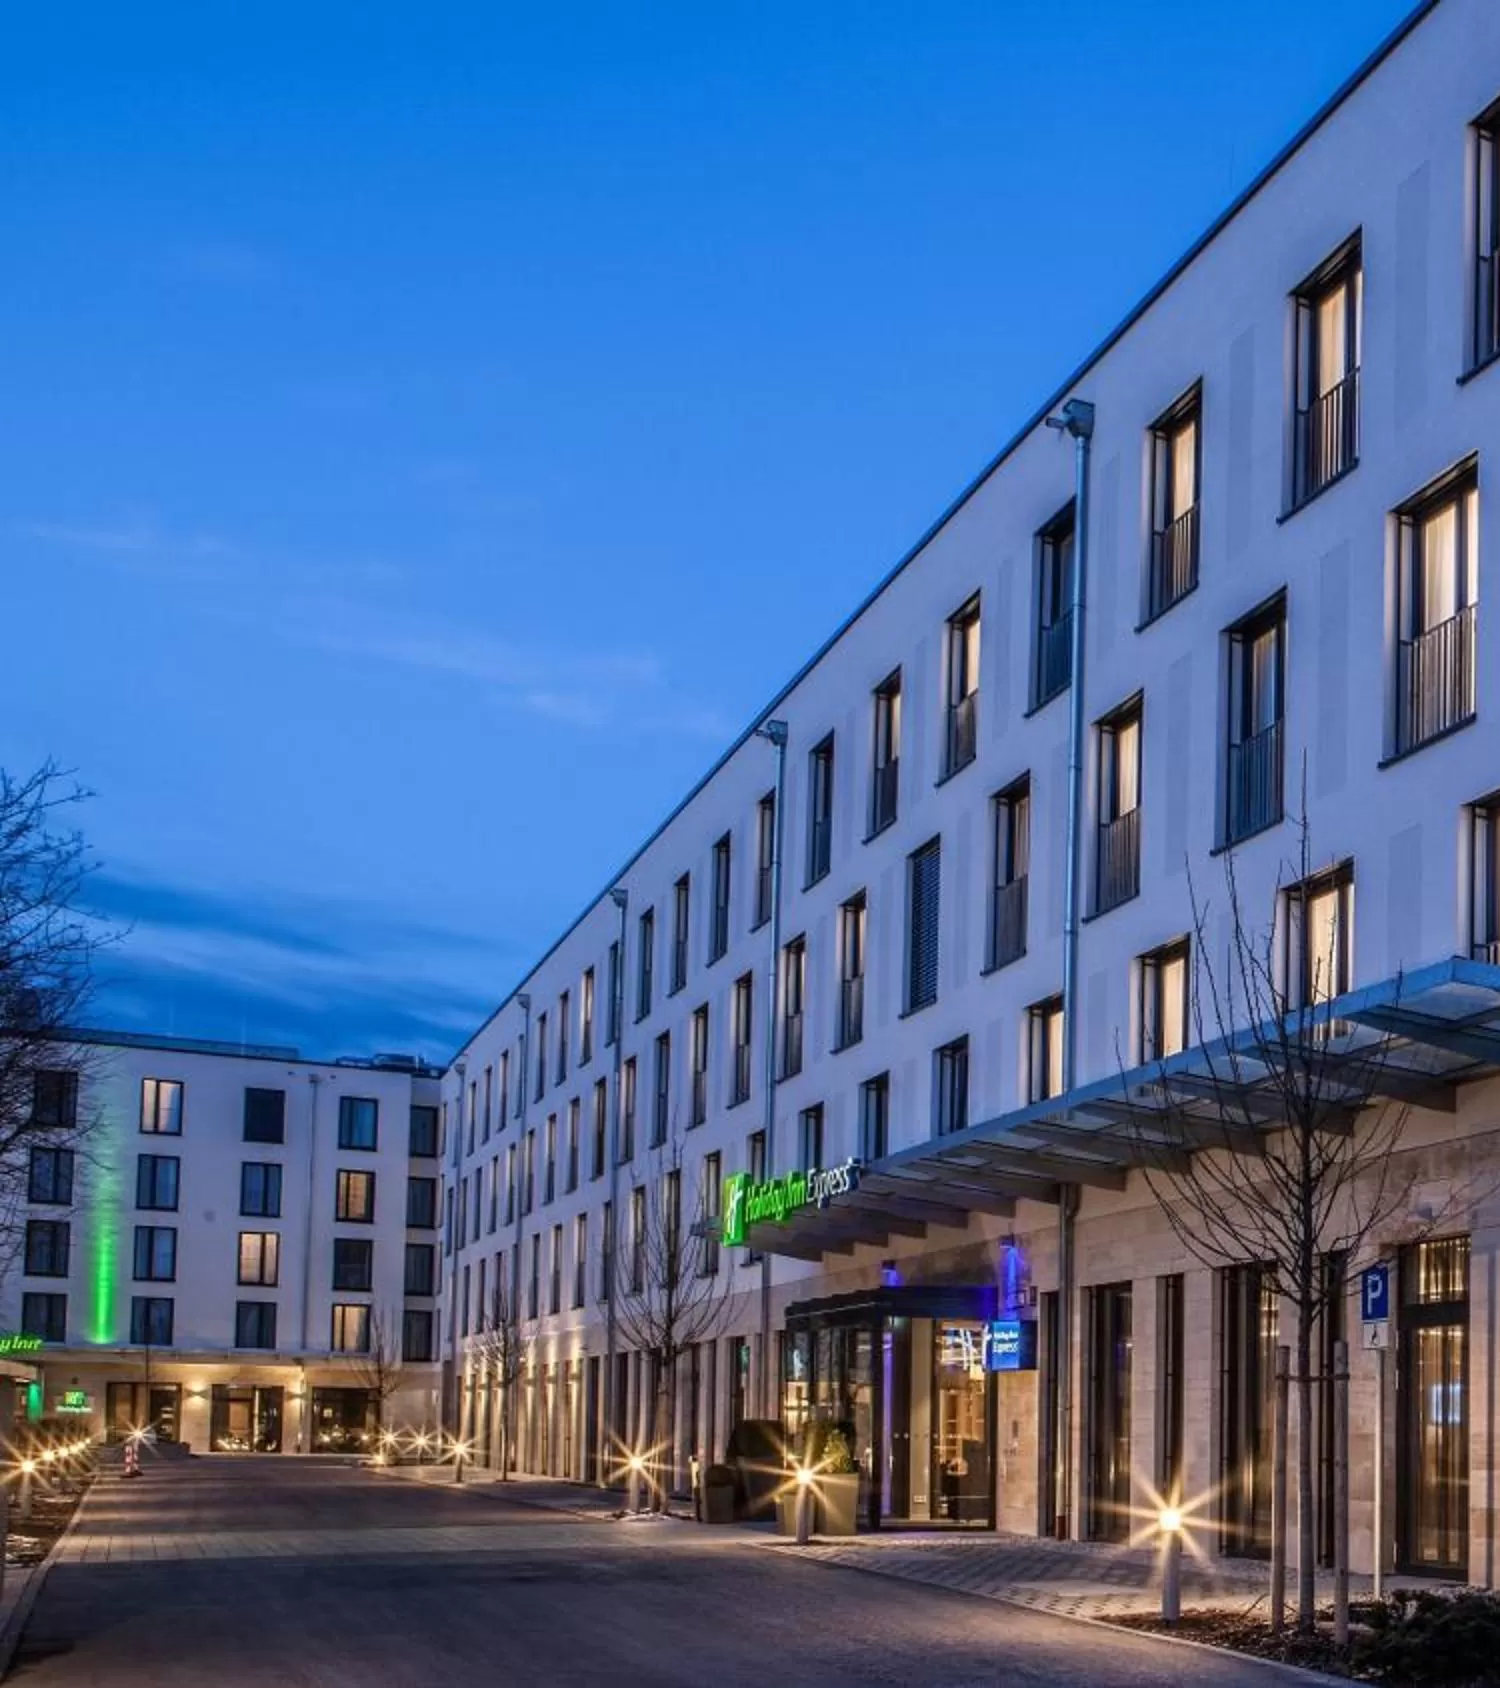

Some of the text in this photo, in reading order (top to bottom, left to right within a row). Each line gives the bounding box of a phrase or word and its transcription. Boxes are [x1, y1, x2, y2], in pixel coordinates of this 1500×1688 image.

[745, 1180, 787, 1222] Holiday
[806, 1167, 850, 1209] Express
[1367, 1274, 1383, 1315] P
